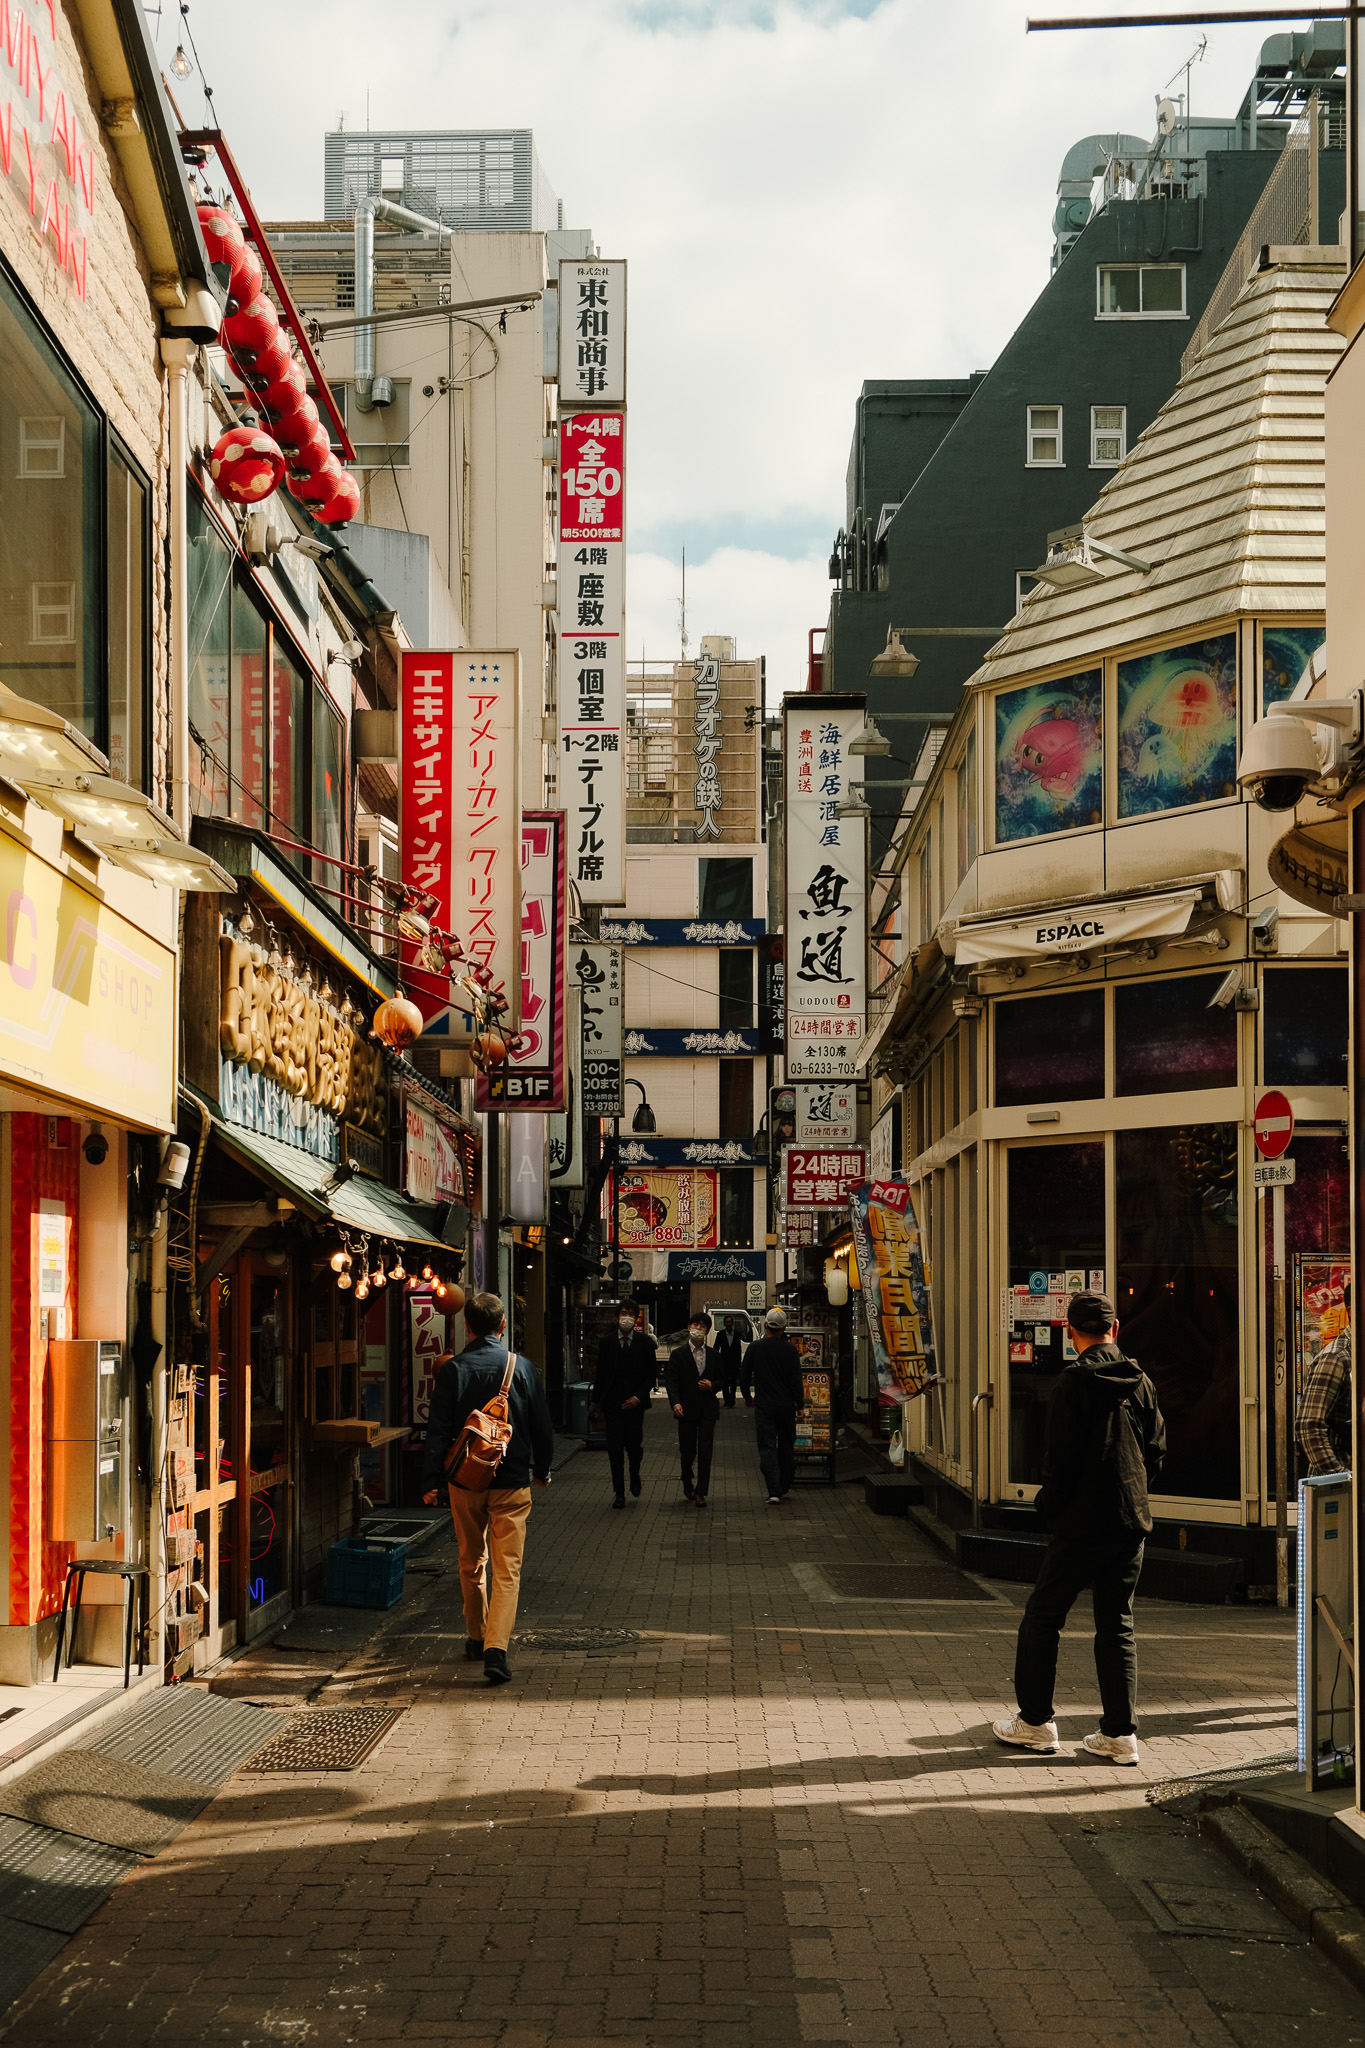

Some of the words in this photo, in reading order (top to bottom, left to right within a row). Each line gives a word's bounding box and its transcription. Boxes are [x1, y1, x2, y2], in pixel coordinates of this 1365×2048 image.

[577, 267, 610, 277] 株式会社
[576, 278, 609, 397] 東和商事
[577, 439, 606, 467] 全
[562, 467, 622, 497] 150
[577, 497, 606, 525] 席
[574, 547, 608, 566] 4階
[577, 572, 605, 628] 座敷
[573, 641, 608, 660] 3階
[577, 668, 605, 723] 個室
[693, 653, 723, 839] カラオケの鉄人
[466, 693, 500, 838] アメリカン
[798, 729, 813, 793] 豊洲直送
[412, 669, 443, 890] エキサイティング
[818, 722, 843, 848] 海鮮居酒屋
[576, 758, 605, 882] テーブル席
[682, 920, 752, 942] カラオケの鉄人
[796, 863, 855, 985] 魚道
[1035, 921, 1105, 944] ESPACE
[99, 956, 152, 1021] SHOP
[799, 996, 837, 1006] UODOU
[794, 1018, 861, 1037] 24時間営業
[682, 1030, 752, 1052] カラオケの鉄人
[804, 1045, 847, 1059] 全130席
[584, 1062, 619, 1075] :00〜
[506, 1078, 549, 1096] B1F
[804, 1126, 850, 1137] 24時間営業
[682, 1140, 752, 1163] カラオケの鉄人
[792, 1154, 862, 1178] 24時間
[1254, 1165, 1292, 1183] 自転車を除く
[677, 1174, 692, 1226] 飲み放題
[787, 1213, 813, 1229] 時間
[654, 1226, 690, 1242] 880円
[787, 1229, 813, 1246] 営業
[677, 1255, 756, 1277] カラオケの鉄人
[807, 1374, 828, 1384] 980
